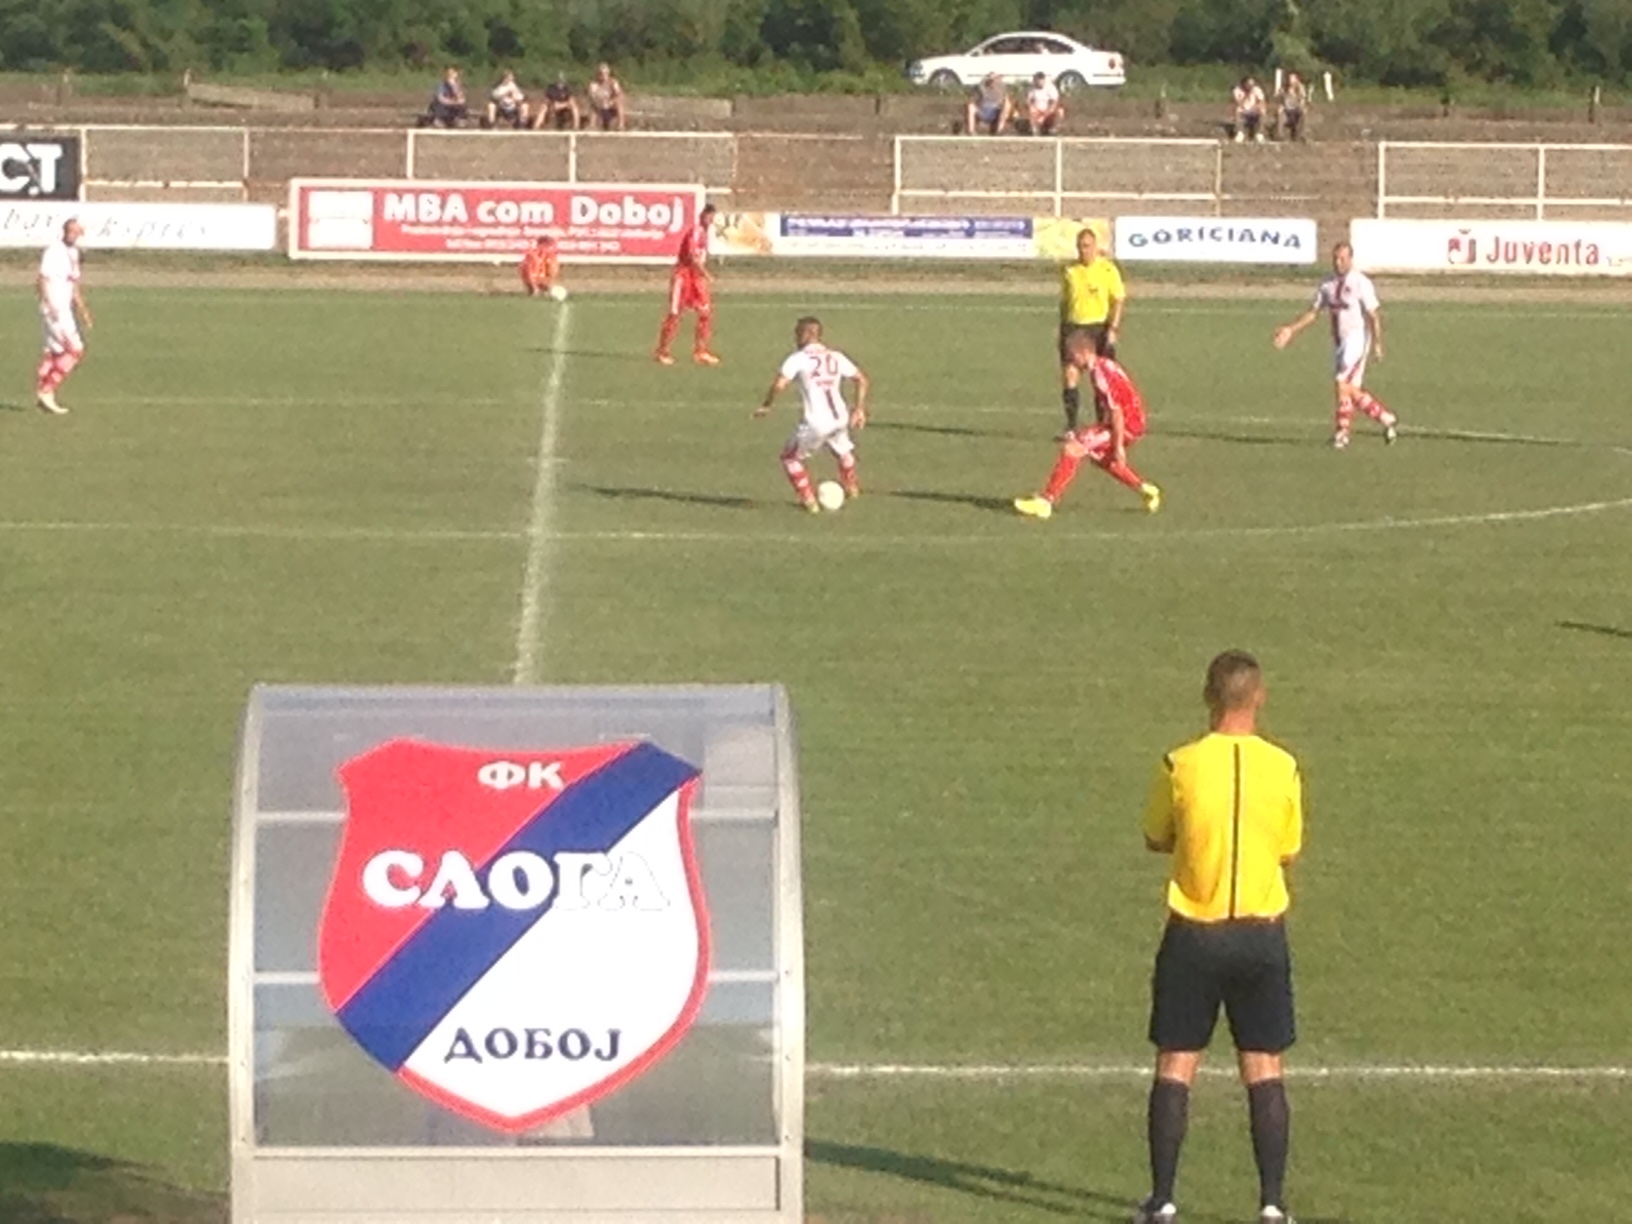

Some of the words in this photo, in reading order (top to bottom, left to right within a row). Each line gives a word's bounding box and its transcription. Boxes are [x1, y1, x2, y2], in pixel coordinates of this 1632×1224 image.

[383, 193, 469, 223] MBA
[477, 200, 554, 224] com
[571, 195, 684, 233] Doboj
[1128, 226, 1302, 249] GORICIANA
[1486, 235, 1600, 266] Juventa
[808, 353, 839, 379] 20
[478, 760, 566, 789] ФК
[361, 849, 671, 912] СЛОГА
[443, 1026, 622, 1065] ДОБОЈ
